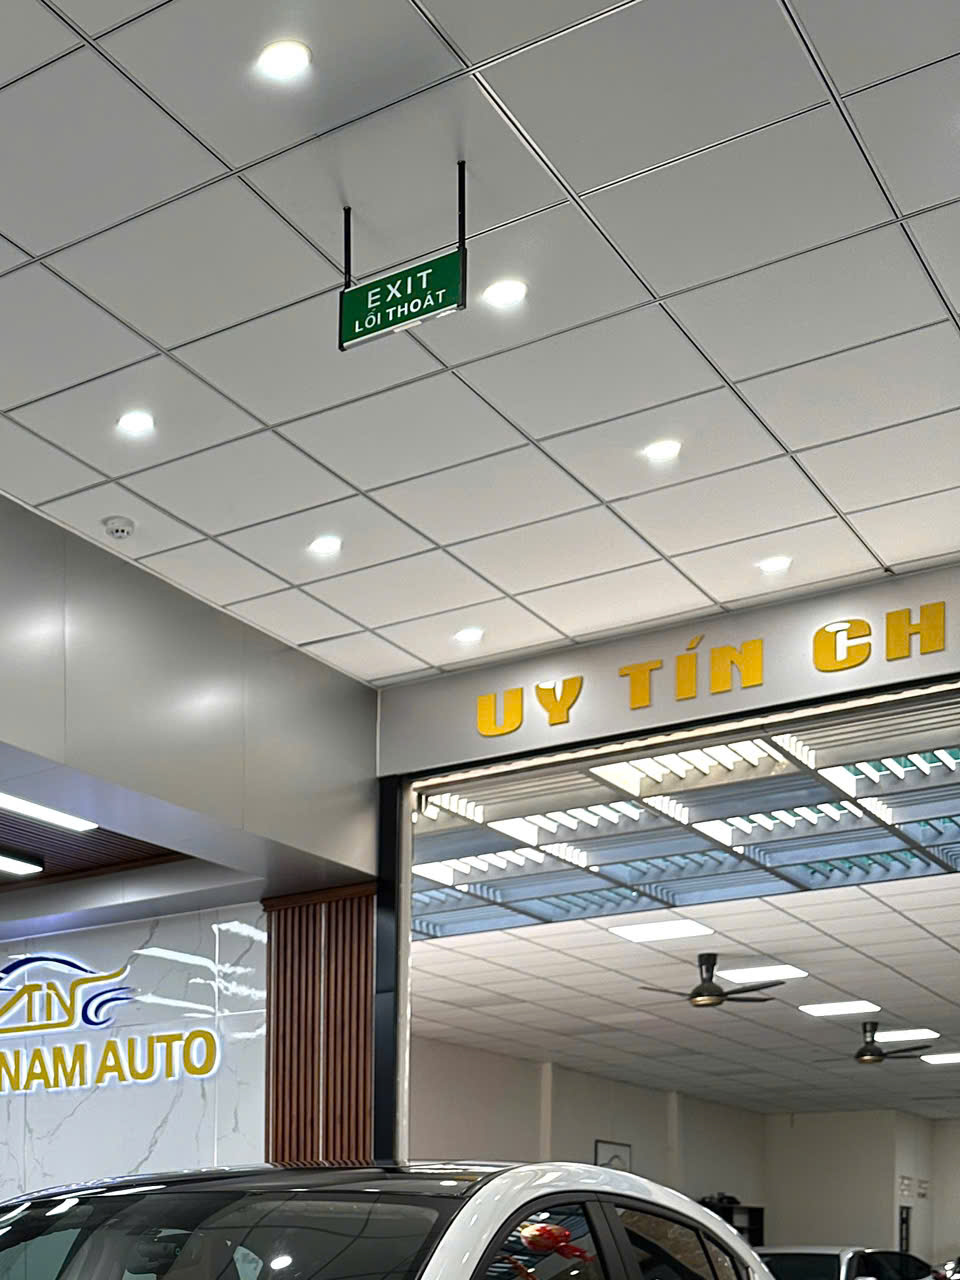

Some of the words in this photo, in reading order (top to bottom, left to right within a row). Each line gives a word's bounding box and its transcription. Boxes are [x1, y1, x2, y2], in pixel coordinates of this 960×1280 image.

[355, 307, 381, 333] LỐI
[386, 289, 446, 321] THOÁT
[367, 268, 433, 308] EXIT
[476, 675, 583, 738] UY
[619, 634, 764, 710] TÍN
[813, 601, 946, 673] CH
[94, 1029, 218, 1085] AUTO
